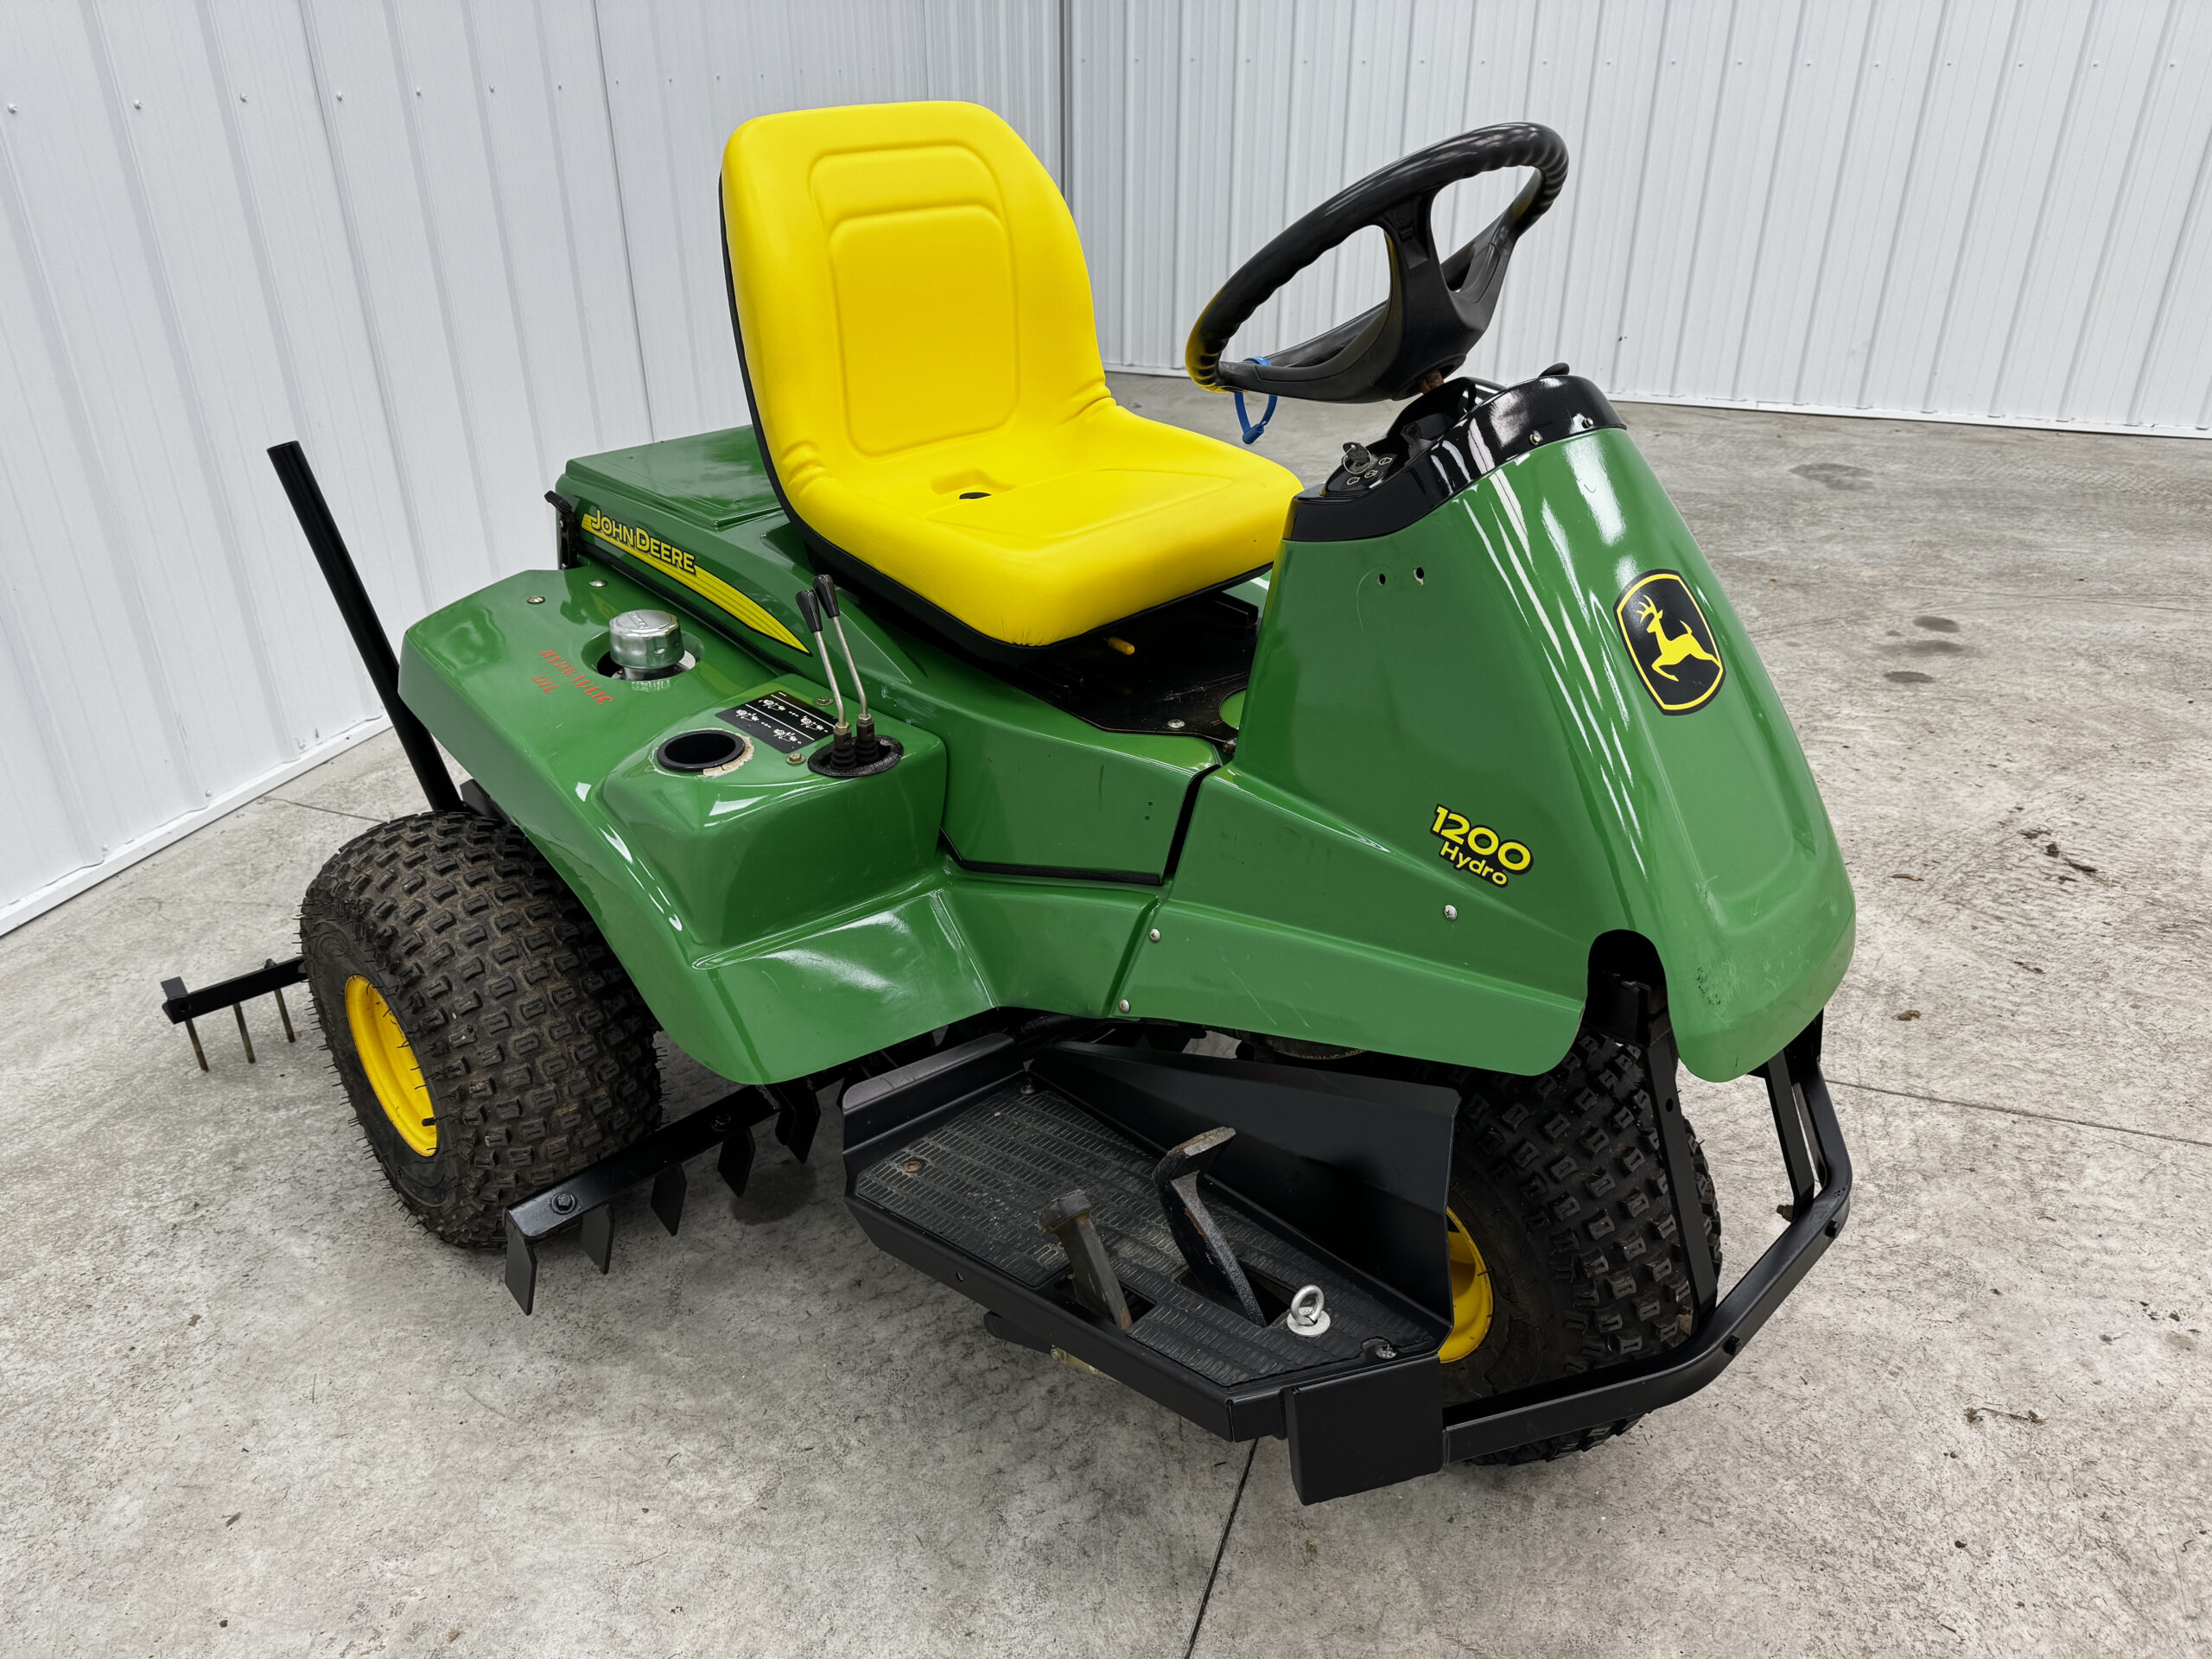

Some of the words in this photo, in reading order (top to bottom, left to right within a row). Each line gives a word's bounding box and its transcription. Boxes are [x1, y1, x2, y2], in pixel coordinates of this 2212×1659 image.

[591, 510, 635, 547] JOHN
[635, 526, 696, 574] DEERE
[531, 674, 558, 694] OIL
[1432, 805, 1531, 871] 1200
[1440, 841, 1508, 886] Hydro
